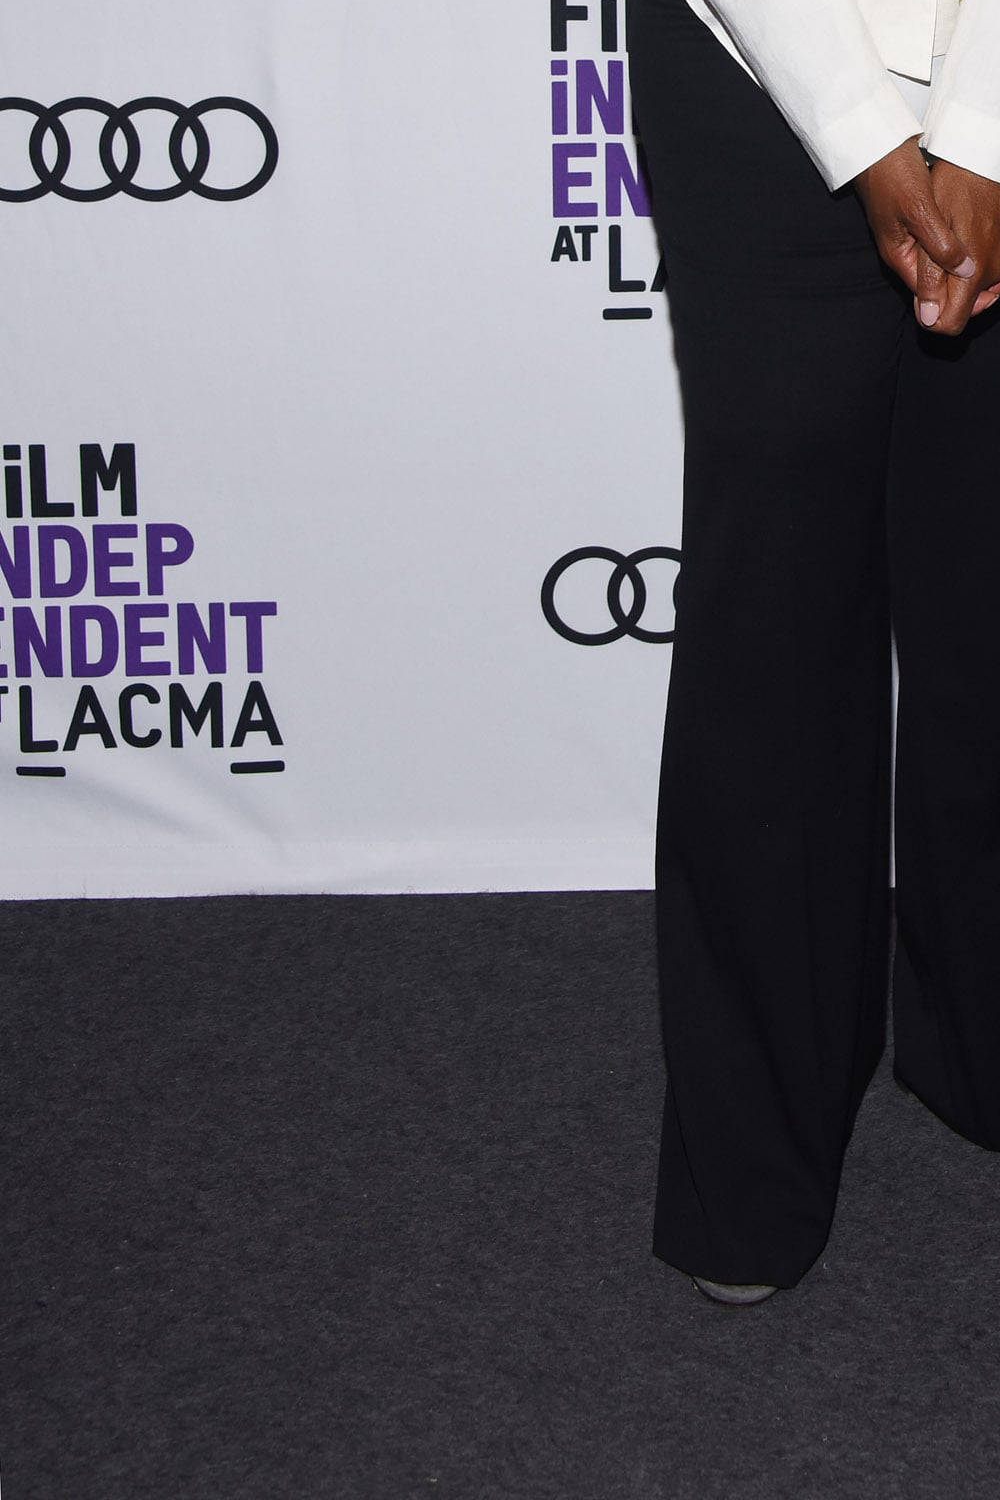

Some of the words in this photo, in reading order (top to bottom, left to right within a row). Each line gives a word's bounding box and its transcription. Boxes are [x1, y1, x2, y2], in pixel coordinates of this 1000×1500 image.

[551, 225, 598, 262] AT
[609, 225, 665, 292] L
[0, 602, 277, 678] NDENT
[19, 681, 284, 753] LACMA
